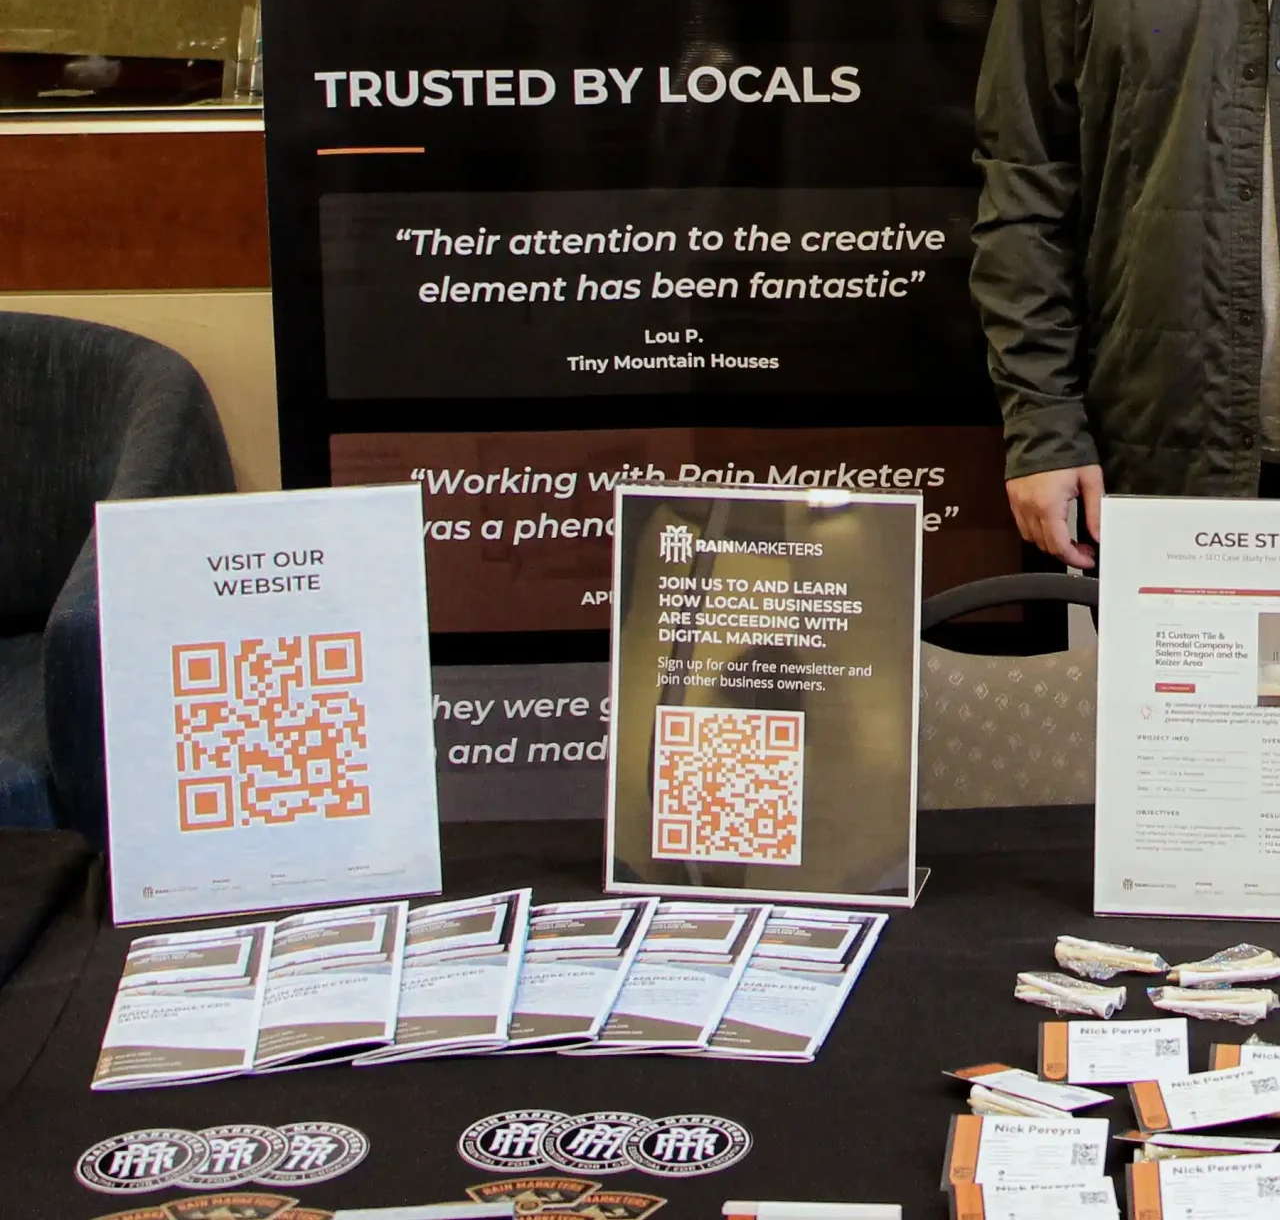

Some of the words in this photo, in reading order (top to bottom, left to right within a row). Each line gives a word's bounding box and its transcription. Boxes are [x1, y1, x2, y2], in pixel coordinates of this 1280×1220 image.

[314, 70, 555, 106] TRUSTED
[574, 68, 642, 104] BY
[660, 66, 860, 102] LOCALS
[509, 226, 676, 254] attention
[688, 227, 723, 250] to
[734, 225, 790, 251] the
[801, 224, 944, 251] creative
[419, 276, 566, 302] element
[577, 274, 640, 300] has
[652, 272, 738, 298] been
[645, 330, 679, 343] Lou
[686, 329, 703, 342] P.
[567, 355, 608, 373] Tiny
[614, 353, 704, 369] Mountain
[711, 354, 779, 368] Houses
[588, 463, 665, 491] with
[767, 463, 945, 488] Marketers
[481, 519, 503, 539] a
[696, 540, 822, 555] RAINMARKETERS
[1195, 532, 1248, 547] CASE
[207, 553, 265, 571] VISIT
[273, 550, 323, 567] OUR
[214, 575, 320, 595] WEBSITE
[658, 576, 696, 589] JOIN
[701, 578, 722, 590] US
[726, 579, 748, 591] TO
[752, 580, 788, 592] AND
[794, 582, 846, 595] LEARN
[660, 594, 700, 607] HOW
[706, 596, 758, 609] LOCAL
[764, 598, 862, 613] BUSINESSES
[658, 612, 690, 624] ARE
[695, 613, 799, 628] SUCCEEDING
[804, 617, 847, 630] WITH
[659, 629, 722, 643] DIGITAL
[726, 632, 826, 647] MARKETING.
[1168, 632, 1200, 640] Custom
[1202, 632, 1216, 640] Tile
[1184, 650, 1214, 660] Oregon
[1194, 642, 1233, 650] Company
[658, 657, 682, 674] Sign
[687, 660, 702, 675] up
[707, 659, 724, 671] for
[727, 661, 748, 671] our
[752, 660, 776, 672] free
[780, 663, 845, 675] newsletter
[848, 665, 871, 676] and
[684, 674, 716, 686] other
[720, 676, 773, 688] business
[777, 680, 825, 690] owners.
[504, 696, 589, 718] were
[449, 737, 517, 764] and
[1080, 1026, 1108, 1036] Nick
[994, 1123, 1024, 1134] Nick
[1028, 1125, 1081, 1136] Pereyra
